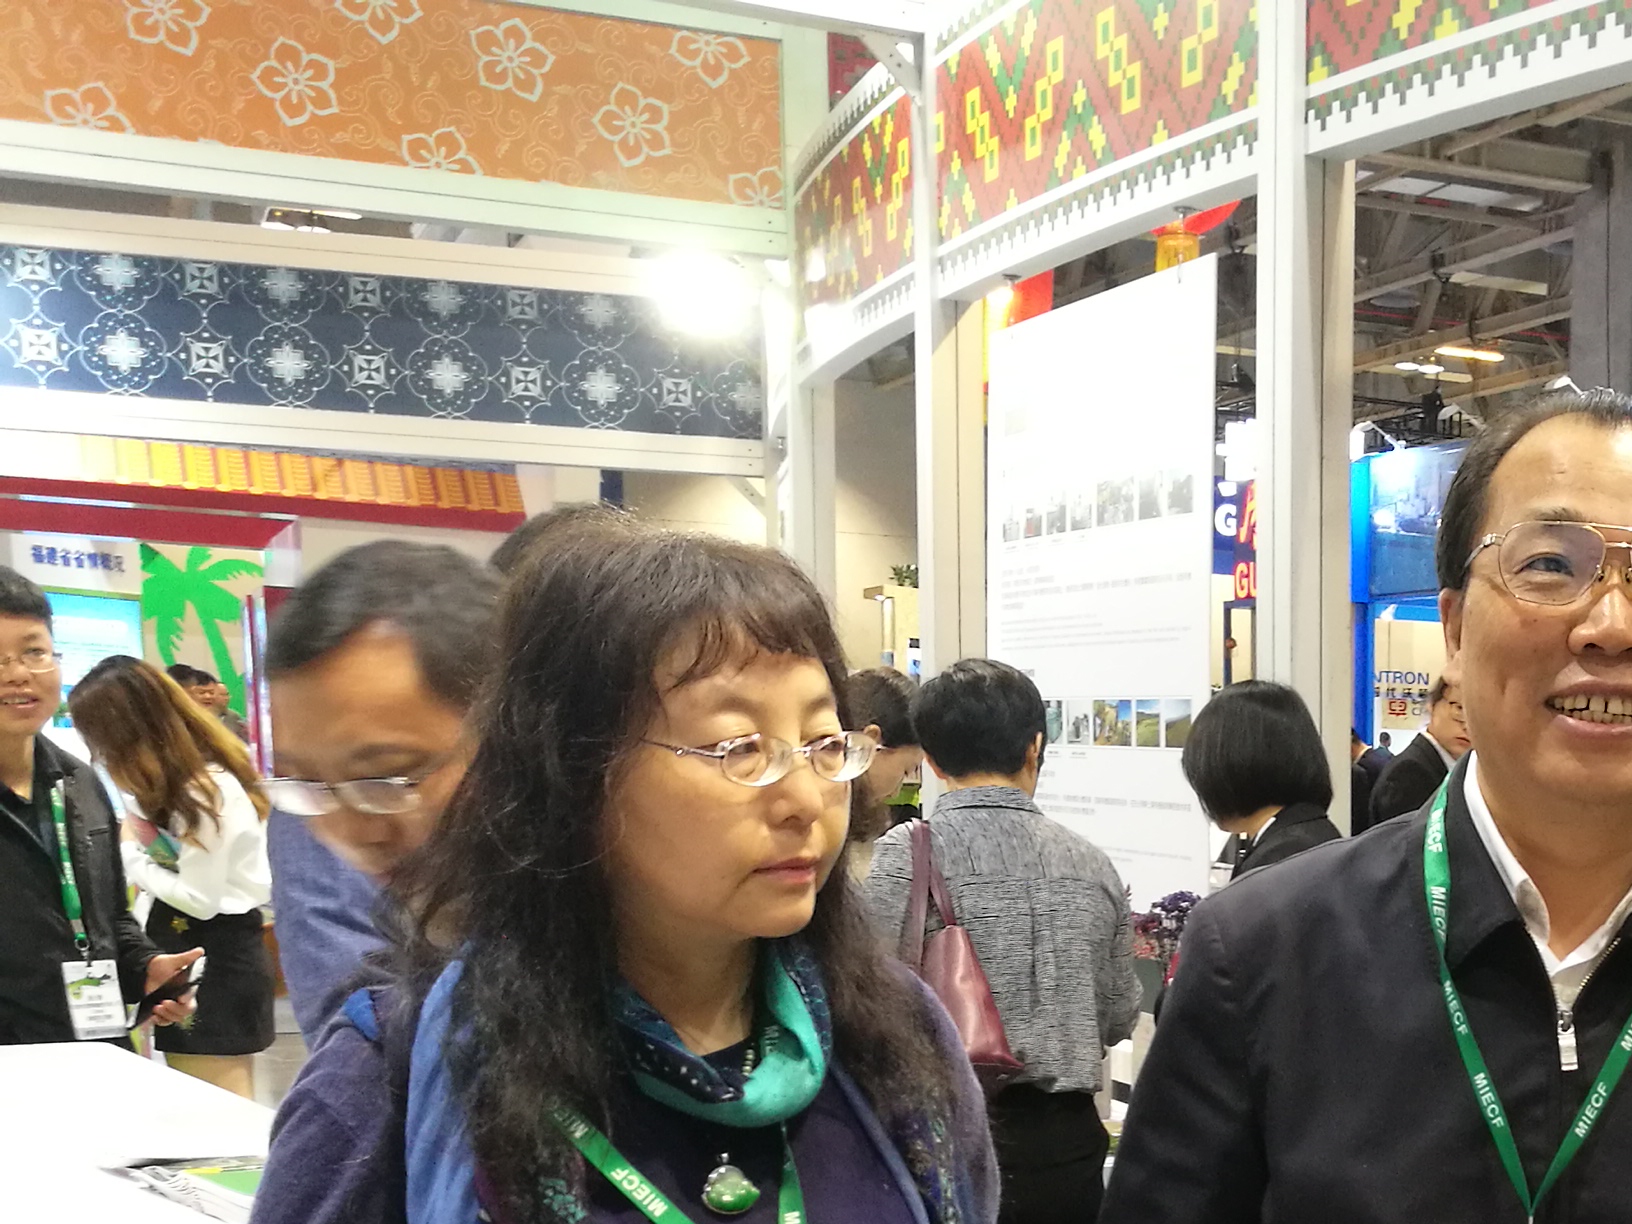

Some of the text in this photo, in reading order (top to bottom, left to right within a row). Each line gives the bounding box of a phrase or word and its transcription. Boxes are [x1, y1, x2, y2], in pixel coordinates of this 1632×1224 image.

[1474, 1072, 1505, 1129] MIECF
[1574, 1081, 1610, 1139] MIECF
[610, 1167, 669, 1218] MIECF
